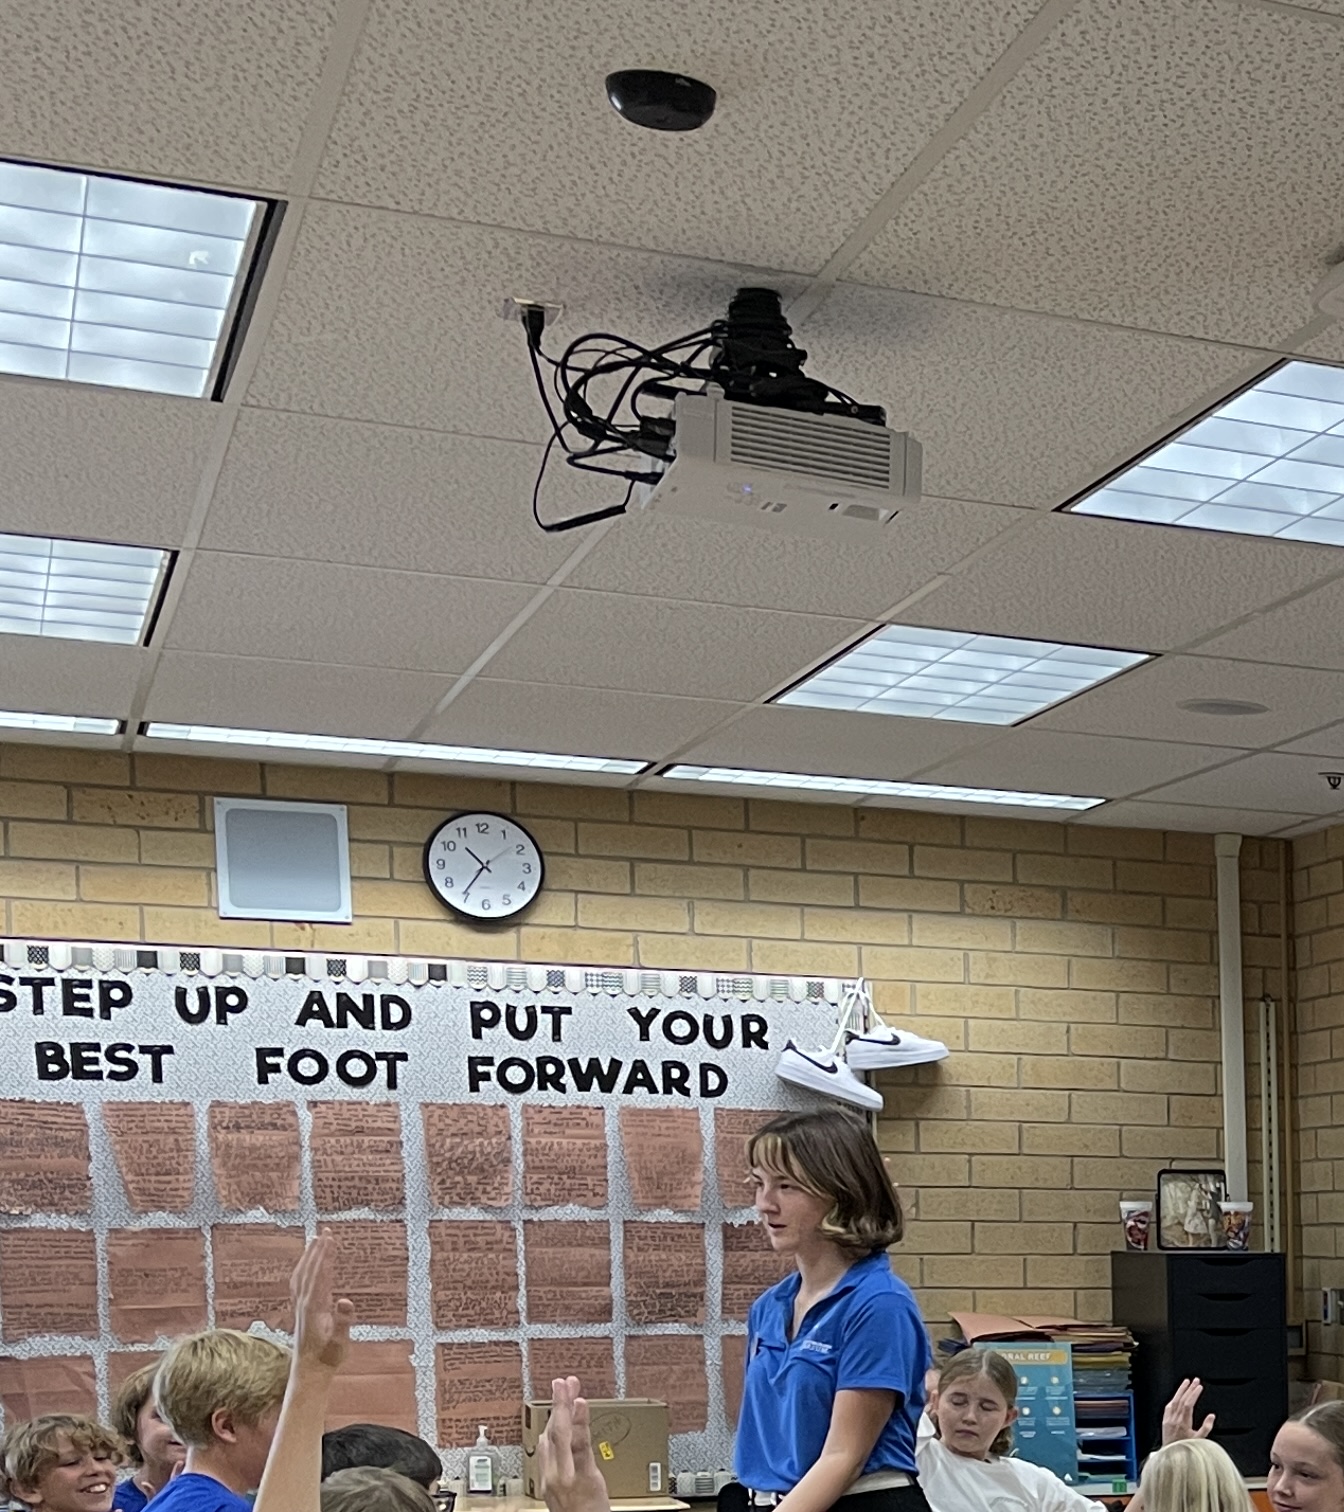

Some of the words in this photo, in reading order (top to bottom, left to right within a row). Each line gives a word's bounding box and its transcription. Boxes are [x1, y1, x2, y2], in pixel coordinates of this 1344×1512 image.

[456, 827, 468, 839] 11
[476, 822, 490, 835] 12
[441, 840, 456, 852] 10
[516, 844, 525, 855] 2
[436, 858, 446, 870] 9
[522, 862, 532, 874] 3
[444, 876, 454, 888] 8
[517, 881, 526, 891] 4
[481, 899, 491, 910] 6
[502, 894, 511, 905] 5
[175, 986, 249, 1026] UP
[295, 990, 412, 1031] AND
[469, 1001, 573, 1043] PUT
[627, 1007, 769, 1050] YOUR
[34, 1041, 174, 1083] BEST
[255, 1047, 409, 1090] FOOT
[467, 1055, 729, 1098] FORWARD
